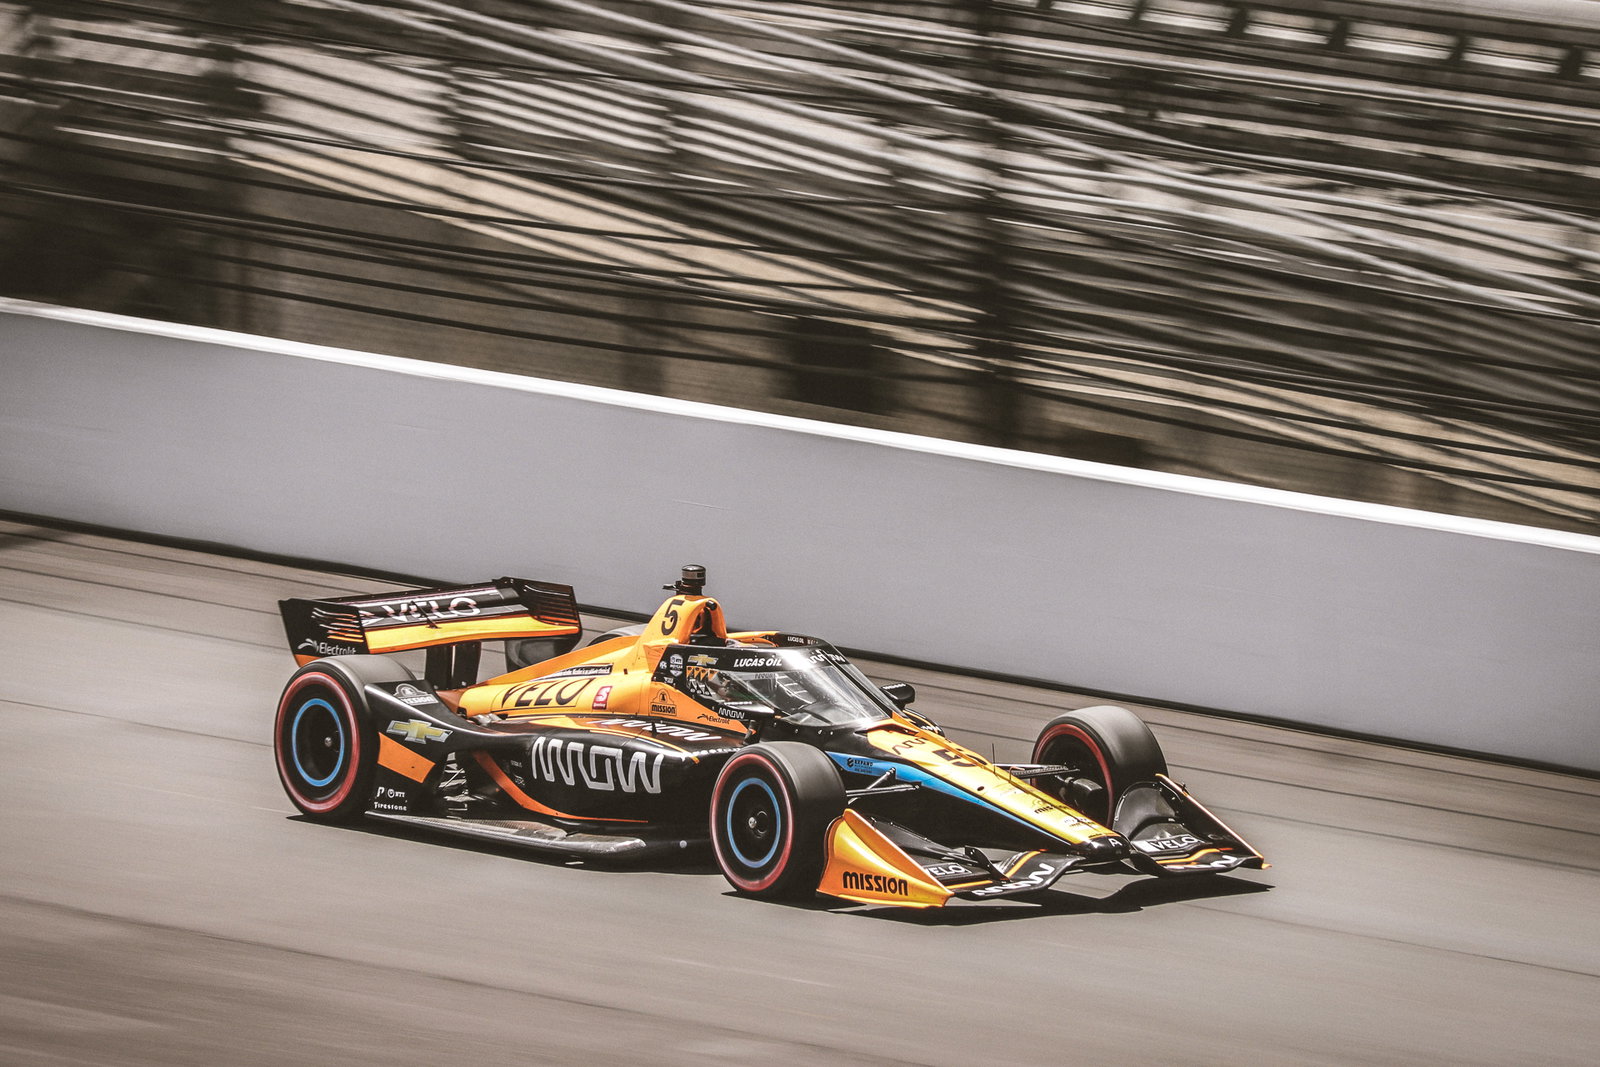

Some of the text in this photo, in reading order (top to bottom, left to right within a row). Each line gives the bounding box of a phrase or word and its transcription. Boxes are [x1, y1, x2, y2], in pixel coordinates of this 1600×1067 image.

[381, 597, 481, 623] VELO
[661, 599, 685, 636] 5
[733, 658, 782, 668] LUCAS OIL
[501, 677, 596, 708] VELO
[531, 736, 664, 794] ARROW
[1150, 837, 1197, 850] VELO
[923, 863, 967, 877] ELO
[842, 871, 909, 897] MISSION
